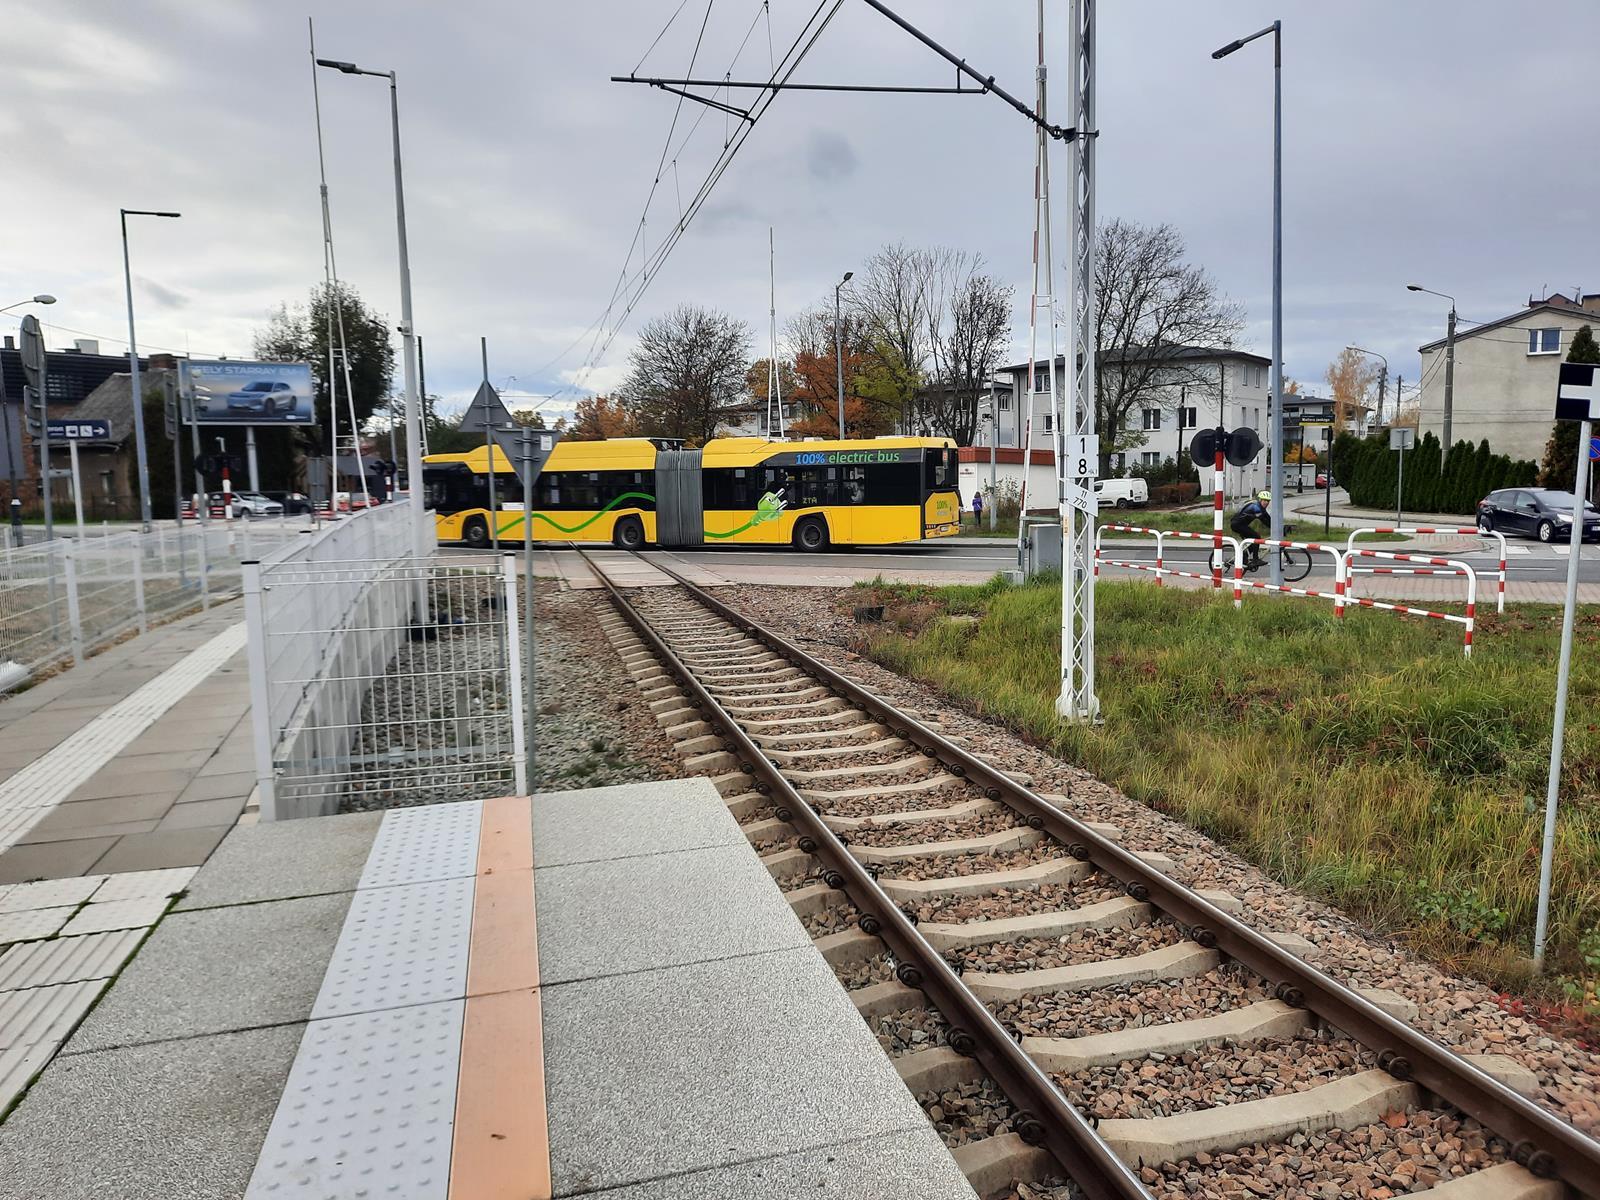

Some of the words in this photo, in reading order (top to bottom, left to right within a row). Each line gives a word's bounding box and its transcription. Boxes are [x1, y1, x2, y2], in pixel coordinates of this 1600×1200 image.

[1080, 437, 1085, 454] 1
[796, 453, 825, 465] 100%
[829, 451, 873, 464] electric
[877, 450, 900, 462] bus
[1079, 458, 1087, 475] 8
[1073, 496, 1087, 509] 770
